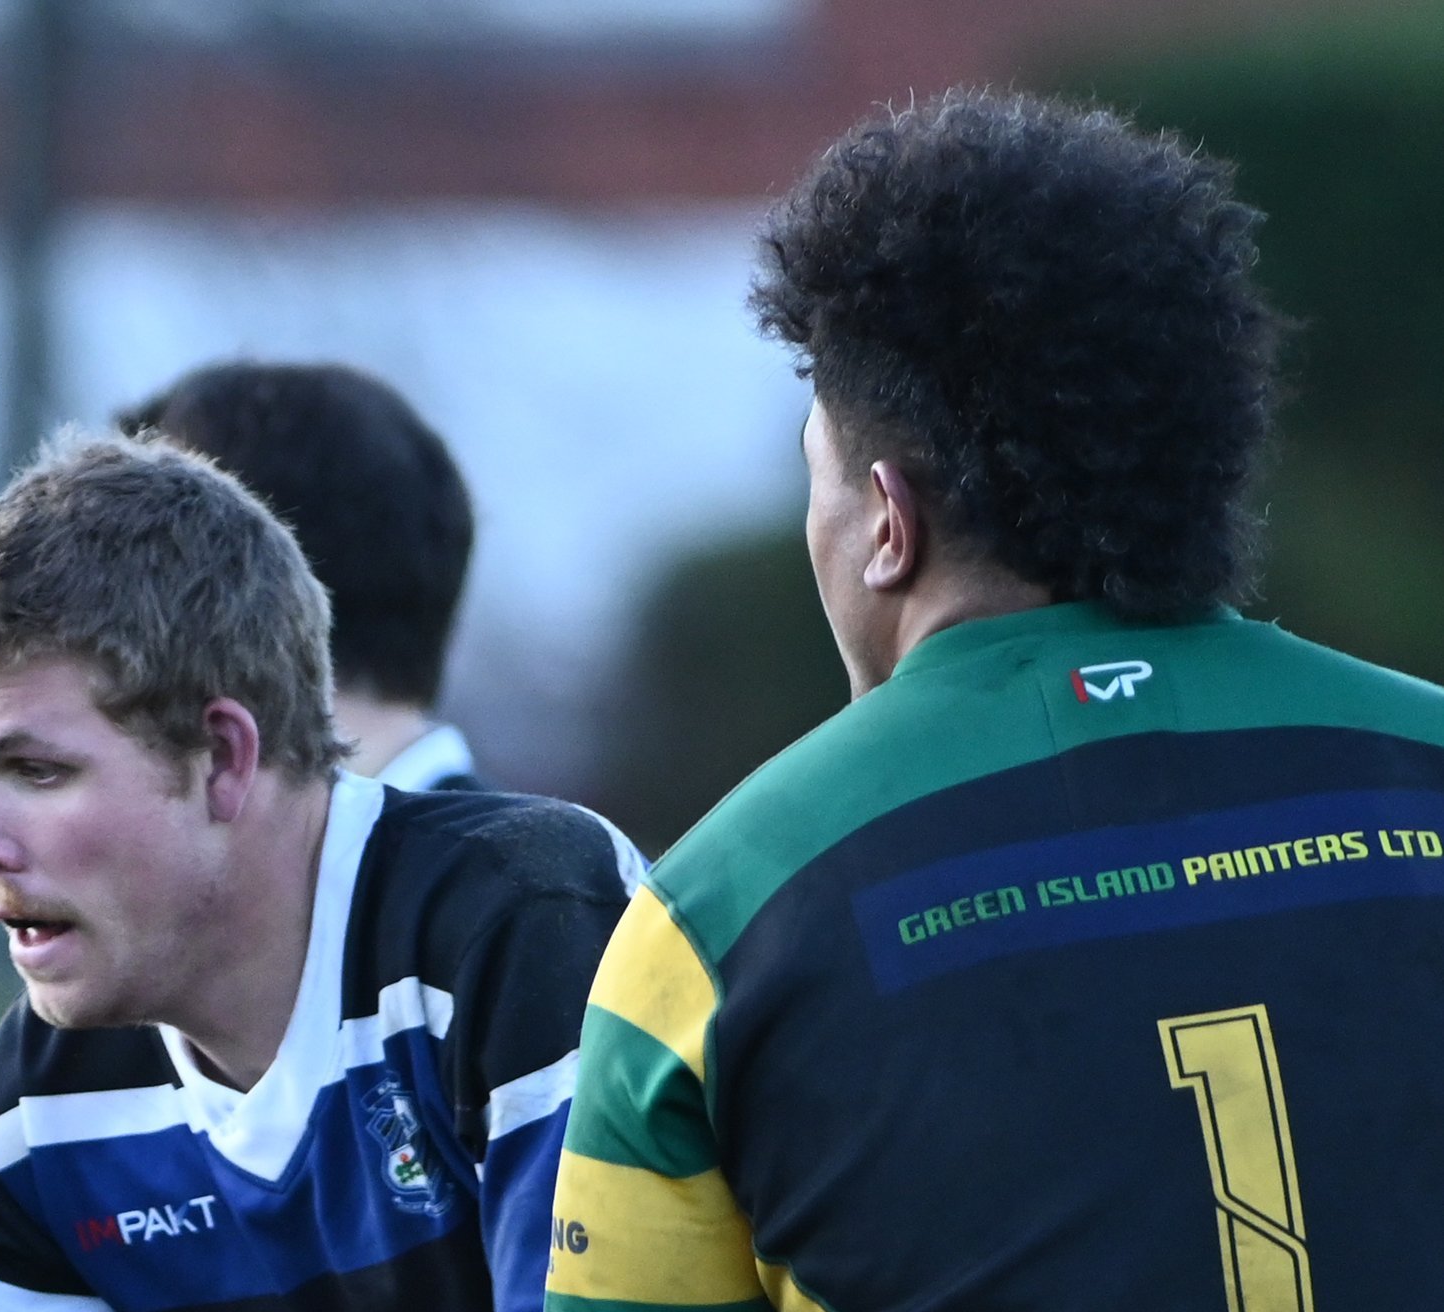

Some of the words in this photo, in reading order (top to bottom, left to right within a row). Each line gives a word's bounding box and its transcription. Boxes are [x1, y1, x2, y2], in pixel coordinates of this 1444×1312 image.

[897, 886, 1027, 945] GREEN
[1038, 862, 1176, 907] ISLAND
[1181, 831, 1369, 886] PAINTERS
[1377, 829, 1443, 858] LTD
[75, 1194, 216, 1252] IMPAKT
